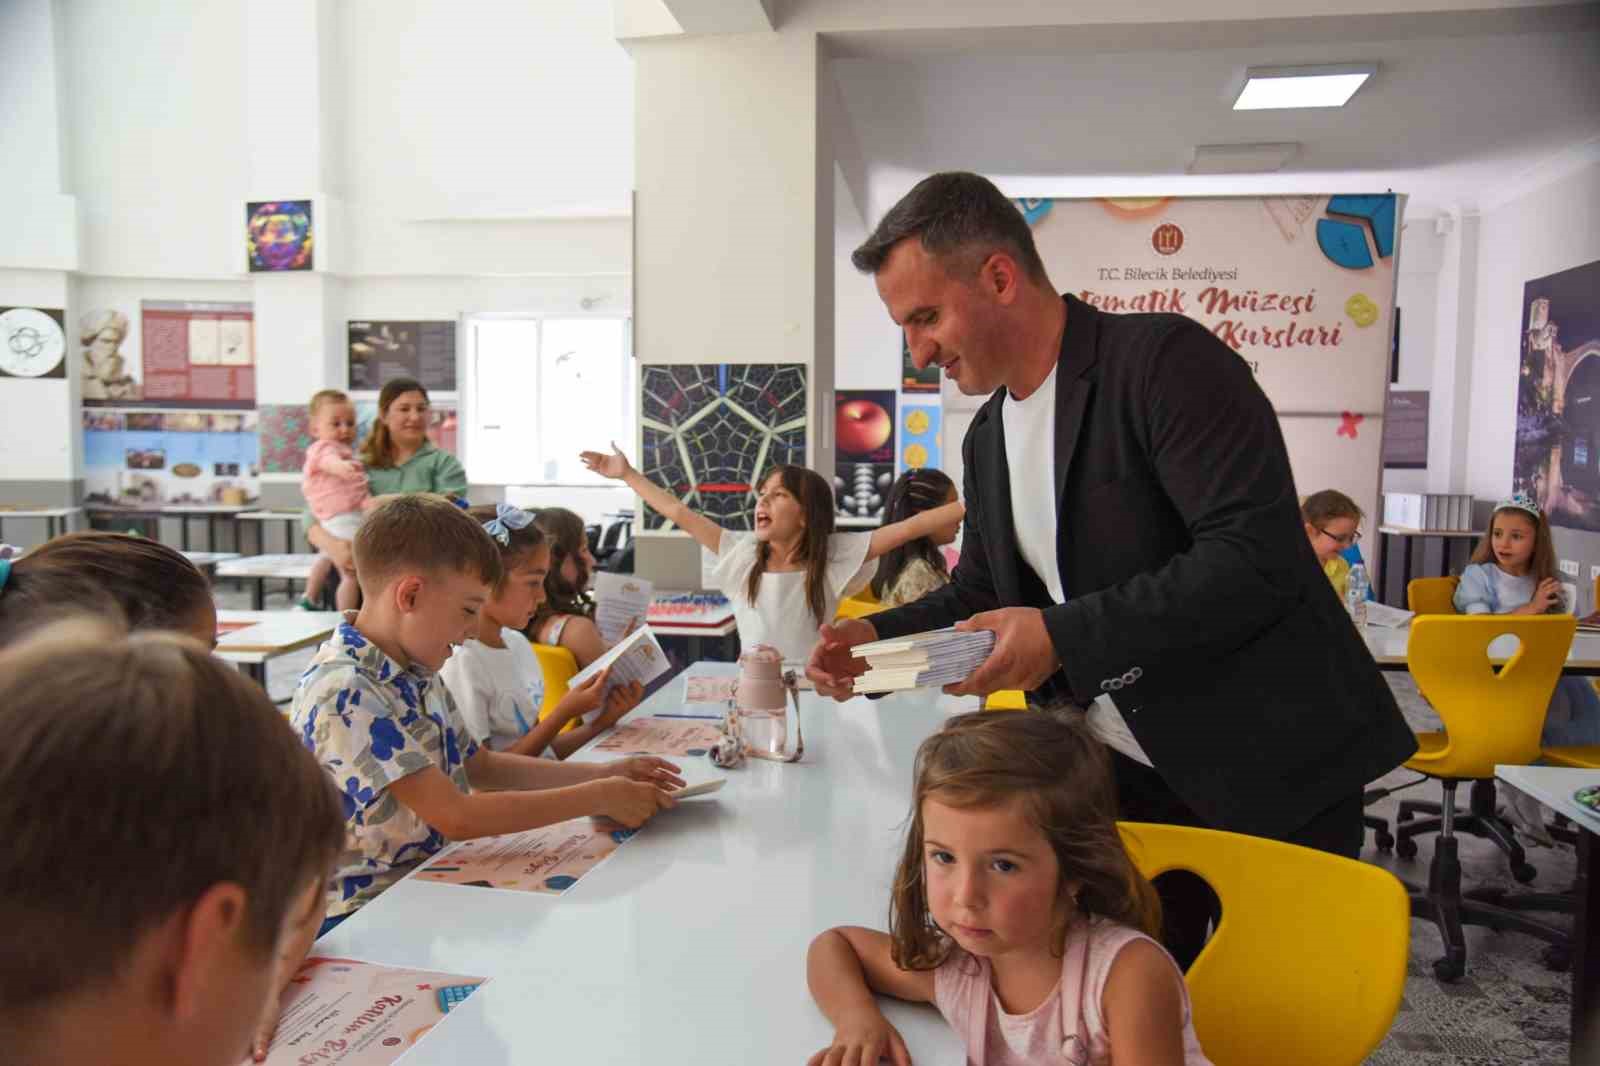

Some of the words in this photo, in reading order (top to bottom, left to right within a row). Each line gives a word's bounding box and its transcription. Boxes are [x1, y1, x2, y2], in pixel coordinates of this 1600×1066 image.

[1124, 266, 1169, 281] Bilecik
[1172, 266, 1238, 284] Belediyesi
[1080, 287, 1187, 313] tematik
[1198, 286, 1316, 315] Müzesi
